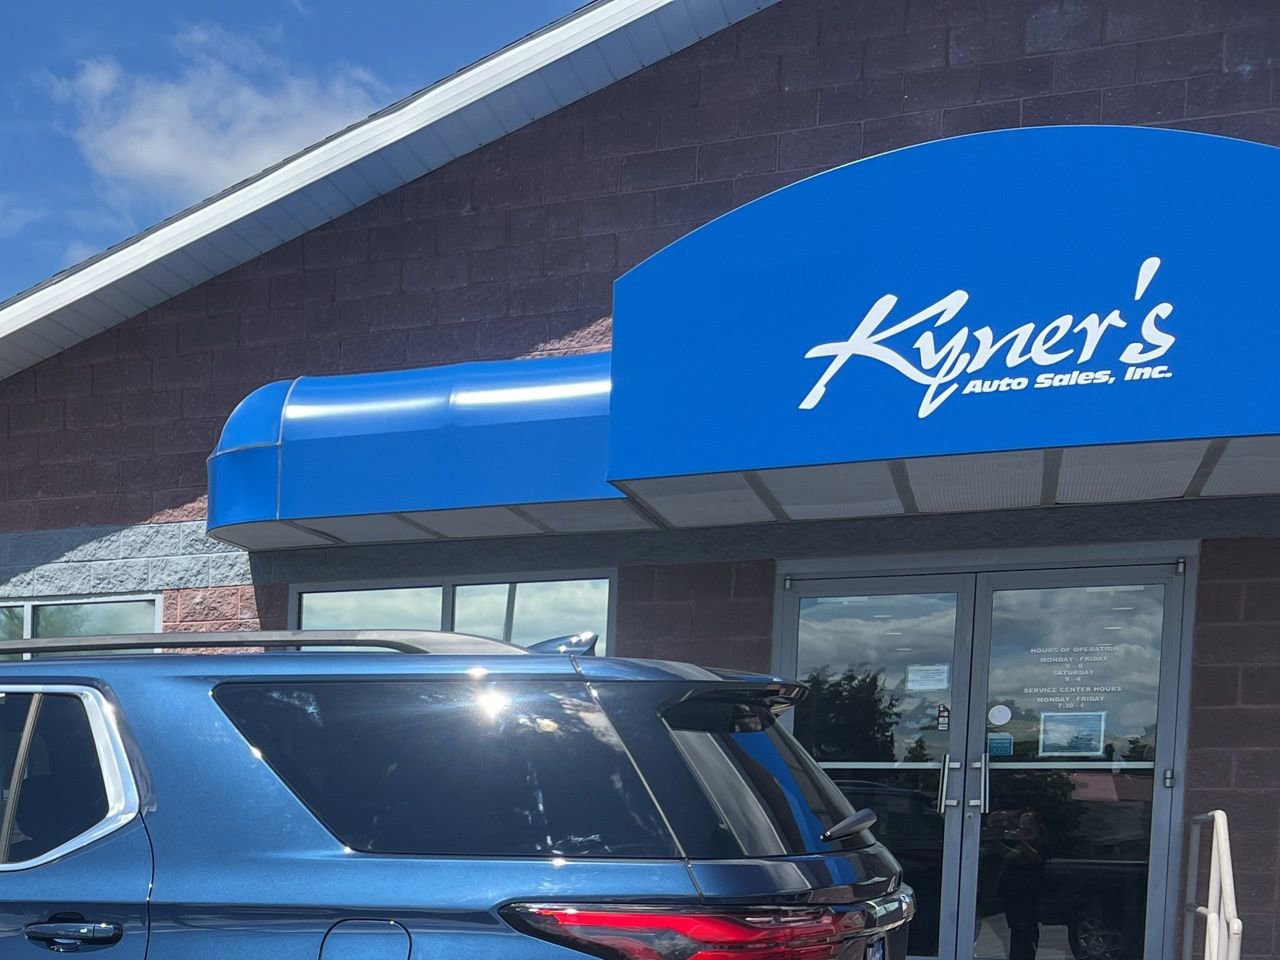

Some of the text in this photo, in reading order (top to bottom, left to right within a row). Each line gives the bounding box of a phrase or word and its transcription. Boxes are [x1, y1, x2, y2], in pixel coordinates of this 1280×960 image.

[798, 256, 1176, 419] Kyner's
[962, 365, 1173, 395] Auto Sales, Inc.
